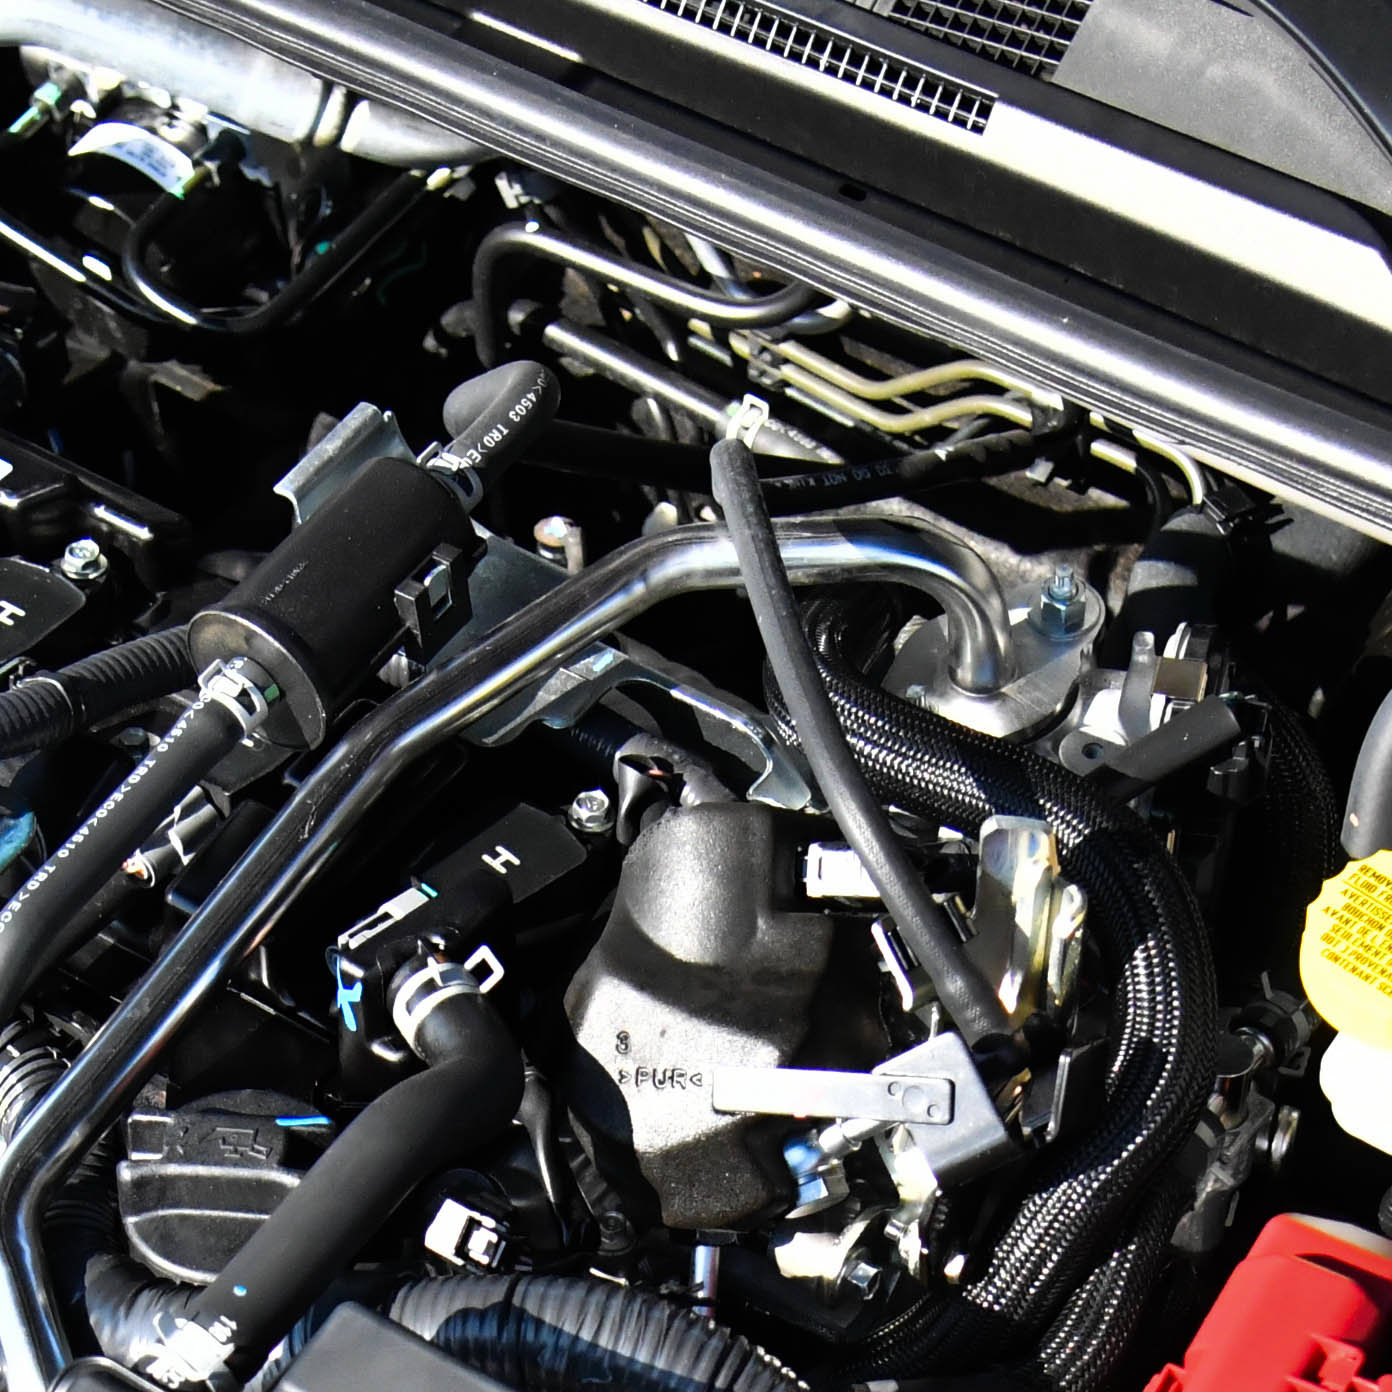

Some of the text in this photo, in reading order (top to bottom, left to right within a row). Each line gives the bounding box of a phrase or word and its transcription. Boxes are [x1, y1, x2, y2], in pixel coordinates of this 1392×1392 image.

[483, 845, 521, 876] H
[1347, 872, 1378, 894] FLUID
[1340, 901, 1386, 932] BOUCHON
[1319, 932, 1342, 949] DOT
[1355, 925, 1373, 938] DE
[1319, 947, 1379, 986] CONTENANT
